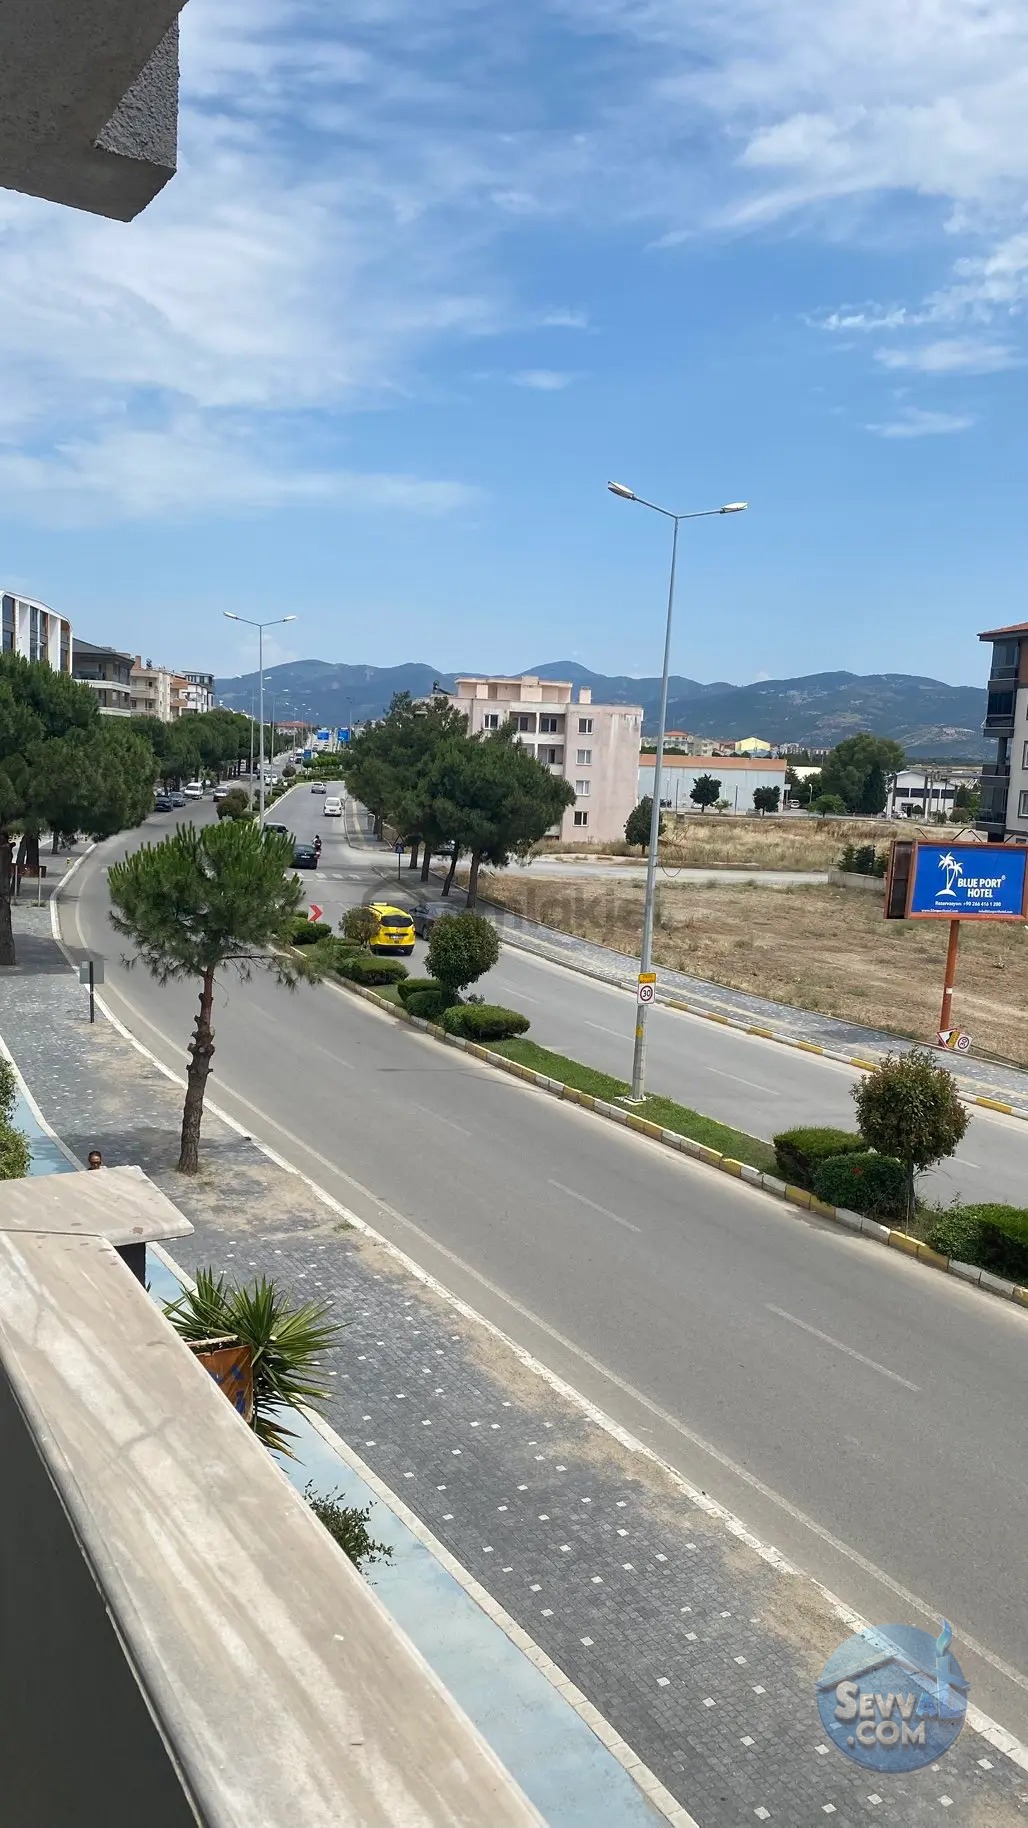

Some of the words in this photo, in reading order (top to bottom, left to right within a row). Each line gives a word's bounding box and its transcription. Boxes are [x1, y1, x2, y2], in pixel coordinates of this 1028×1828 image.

[957, 878, 978, 887] BLUE
[979, 878, 1002, 888] PORT
[967, 889, 993, 897] HOTEL
